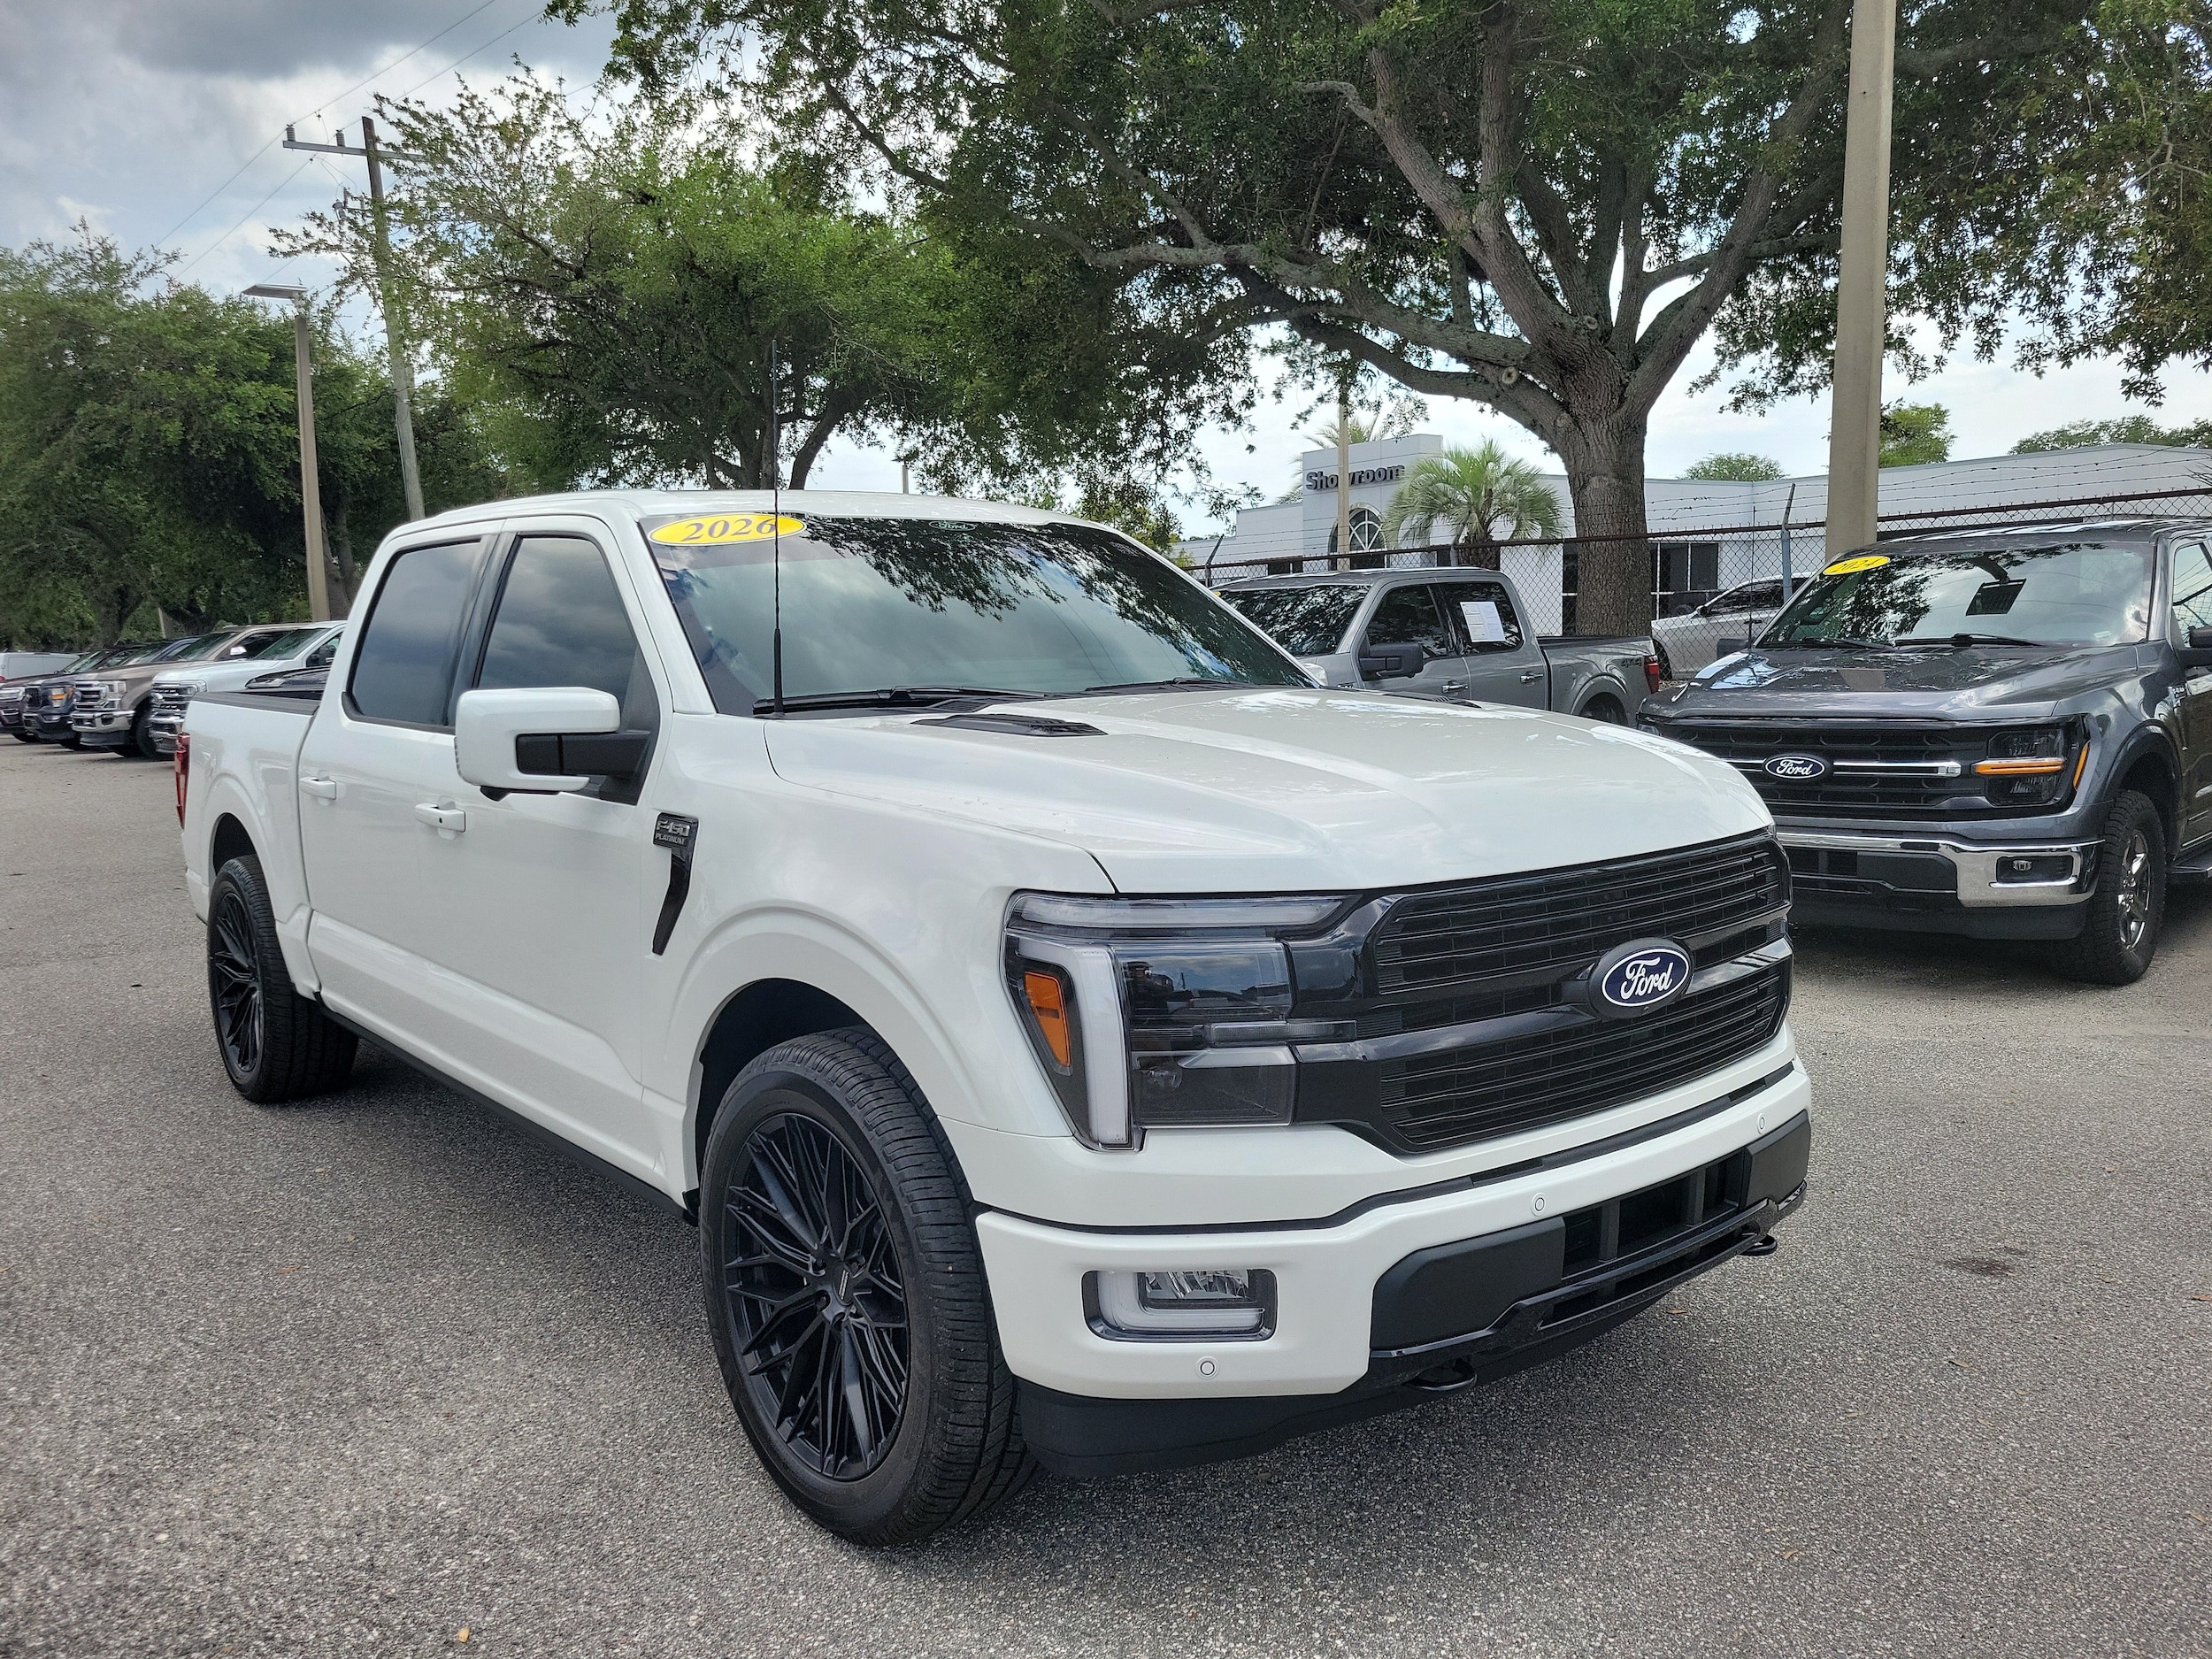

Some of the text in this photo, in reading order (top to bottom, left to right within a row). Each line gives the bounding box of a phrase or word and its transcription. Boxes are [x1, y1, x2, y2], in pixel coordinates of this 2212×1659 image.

[680, 518, 776, 542] 2026
[1776, 759, 1814, 775] Ford
[655, 833, 685, 845] PLATINUM
[1620, 956, 1674, 1000] Ford
